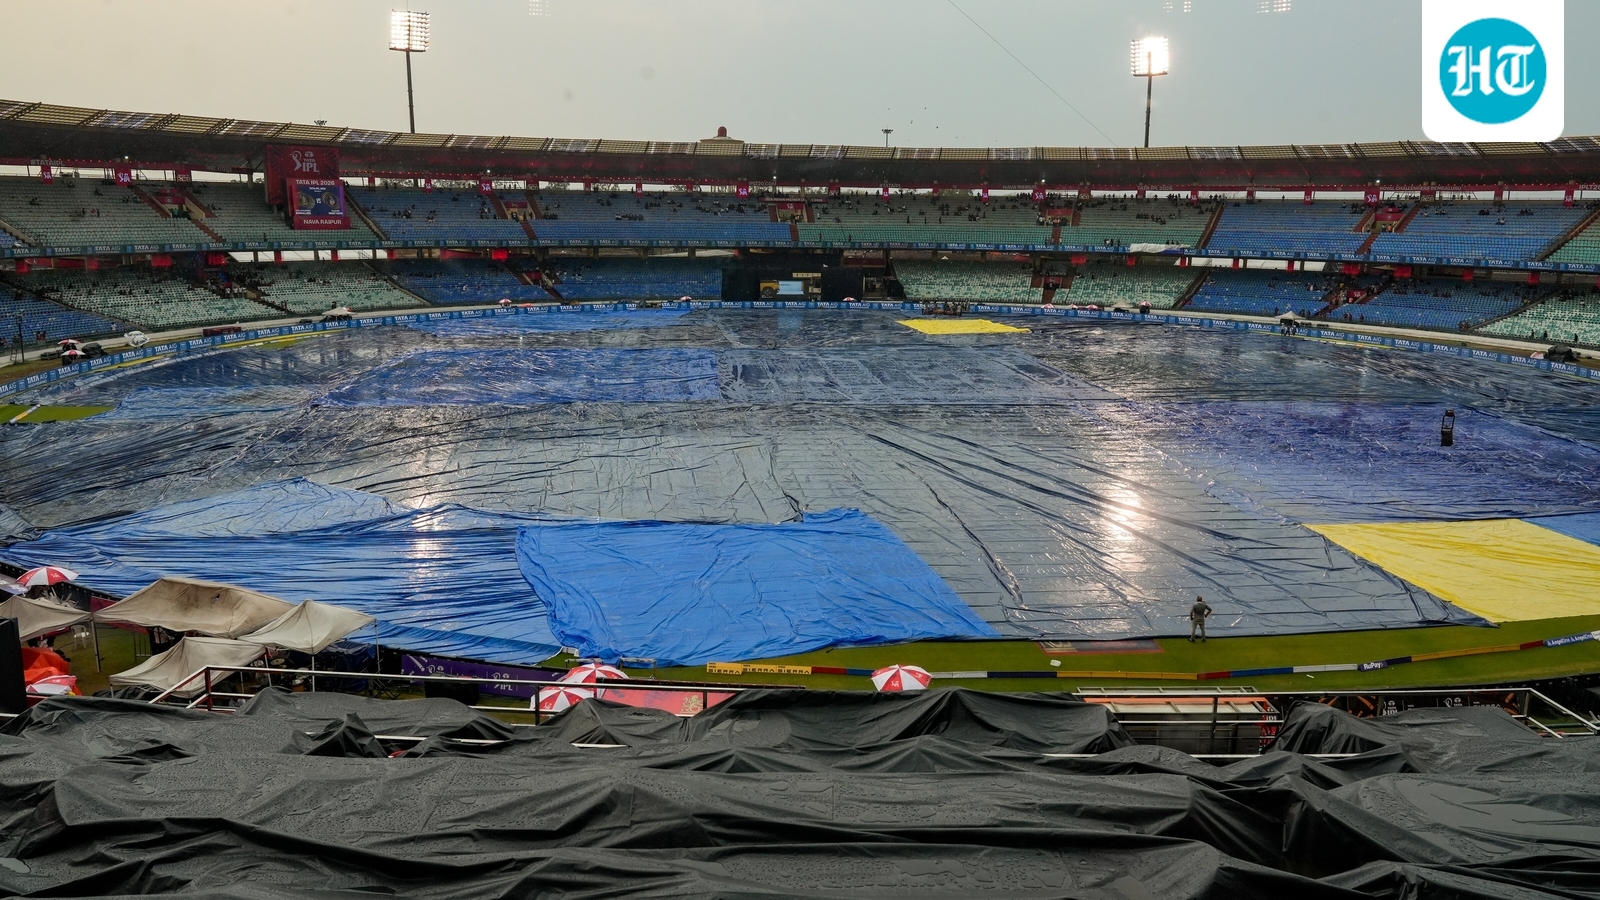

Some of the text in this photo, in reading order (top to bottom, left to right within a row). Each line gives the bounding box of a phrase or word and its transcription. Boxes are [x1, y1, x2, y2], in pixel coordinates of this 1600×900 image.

[303, 162, 319, 172] IPL
[122, 349, 144, 359] TATA AIG
[90, 356, 112, 367] TATA AIG
[58, 364, 79, 375] TATA AIG
[27, 373, 48, 384] TATA AIG
[1364, 662, 1381, 670] RuPay
